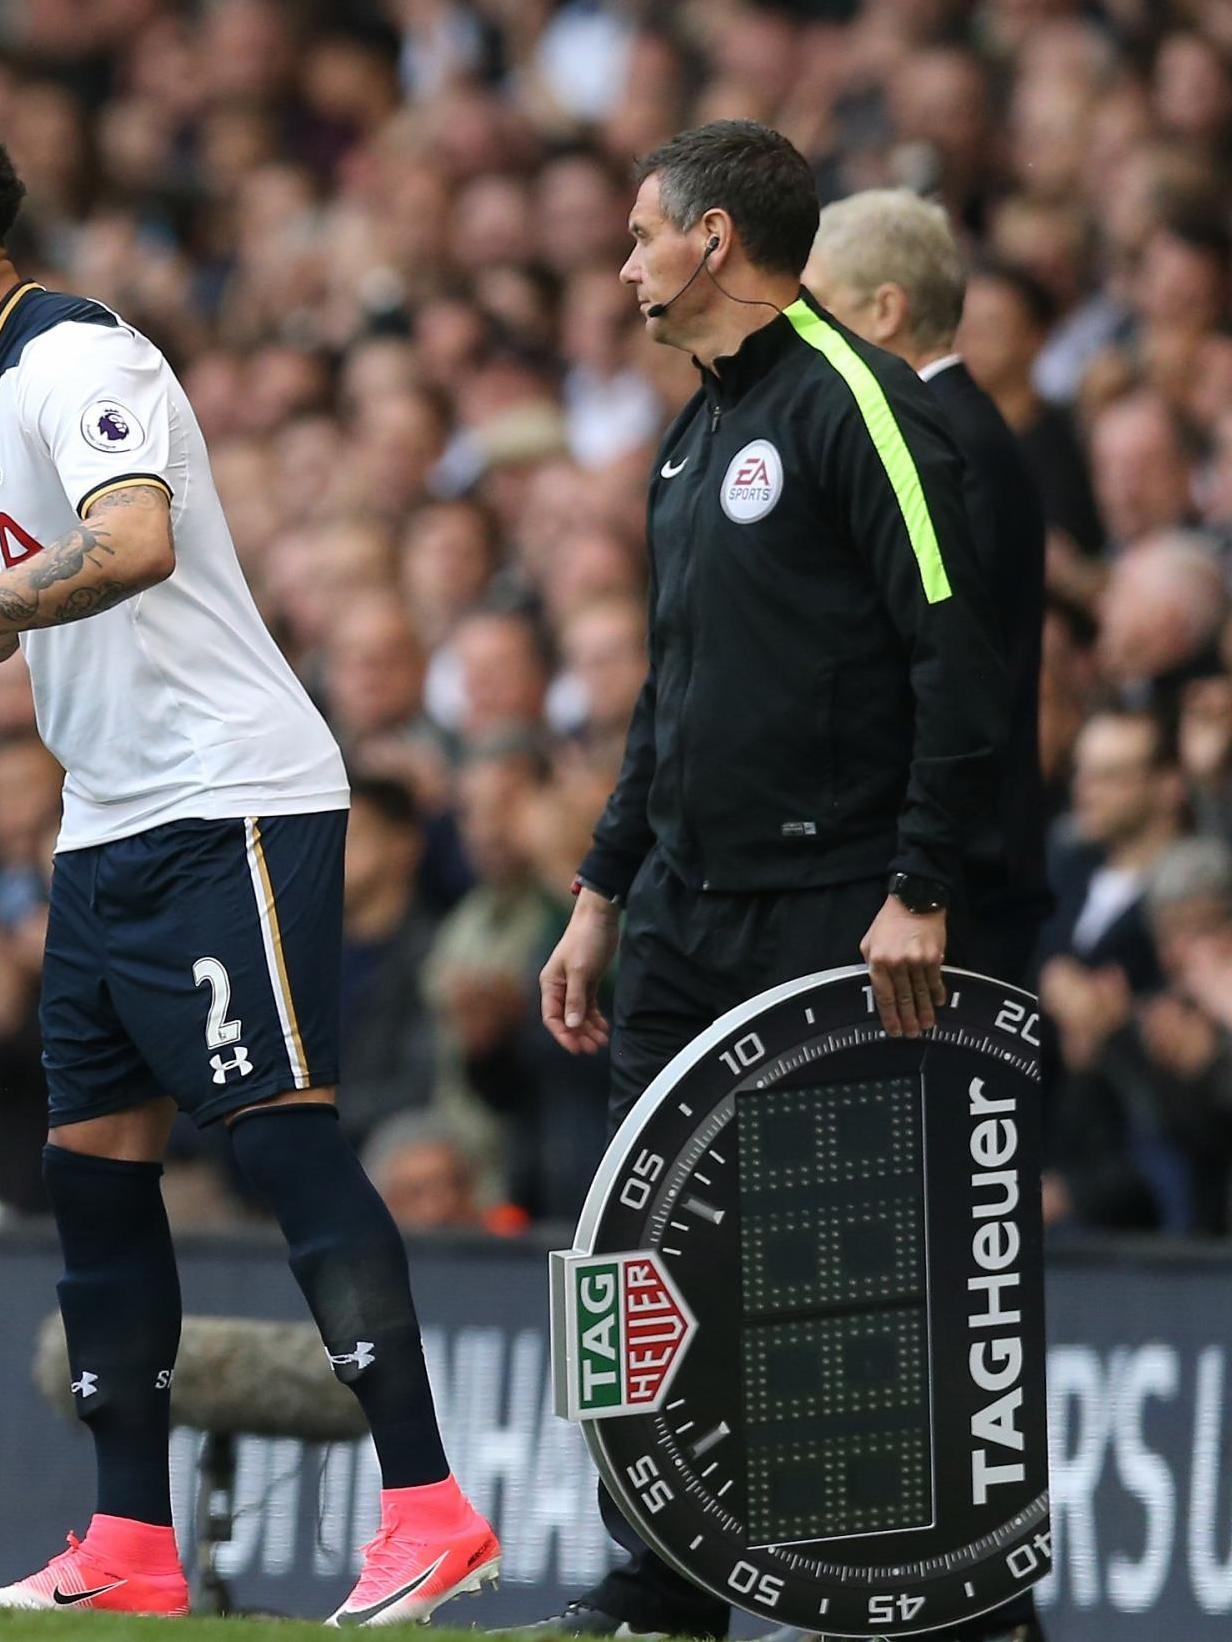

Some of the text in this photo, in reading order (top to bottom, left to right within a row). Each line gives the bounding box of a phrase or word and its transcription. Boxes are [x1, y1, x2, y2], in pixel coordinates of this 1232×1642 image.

[728, 488, 771, 501] SPORTS
[734, 458, 770, 486] EA
[192, 956, 242, 1050] 2
[719, 1032, 765, 1075] 10
[620, 1149, 665, 1210] 05
[580, 1273, 617, 1402] TAG
[627, 1265, 683, 1399] HEUER
[626, 1455, 675, 1514] 55
[727, 1560, 785, 1606] 50
[869, 1594, 926, 1624] 45
